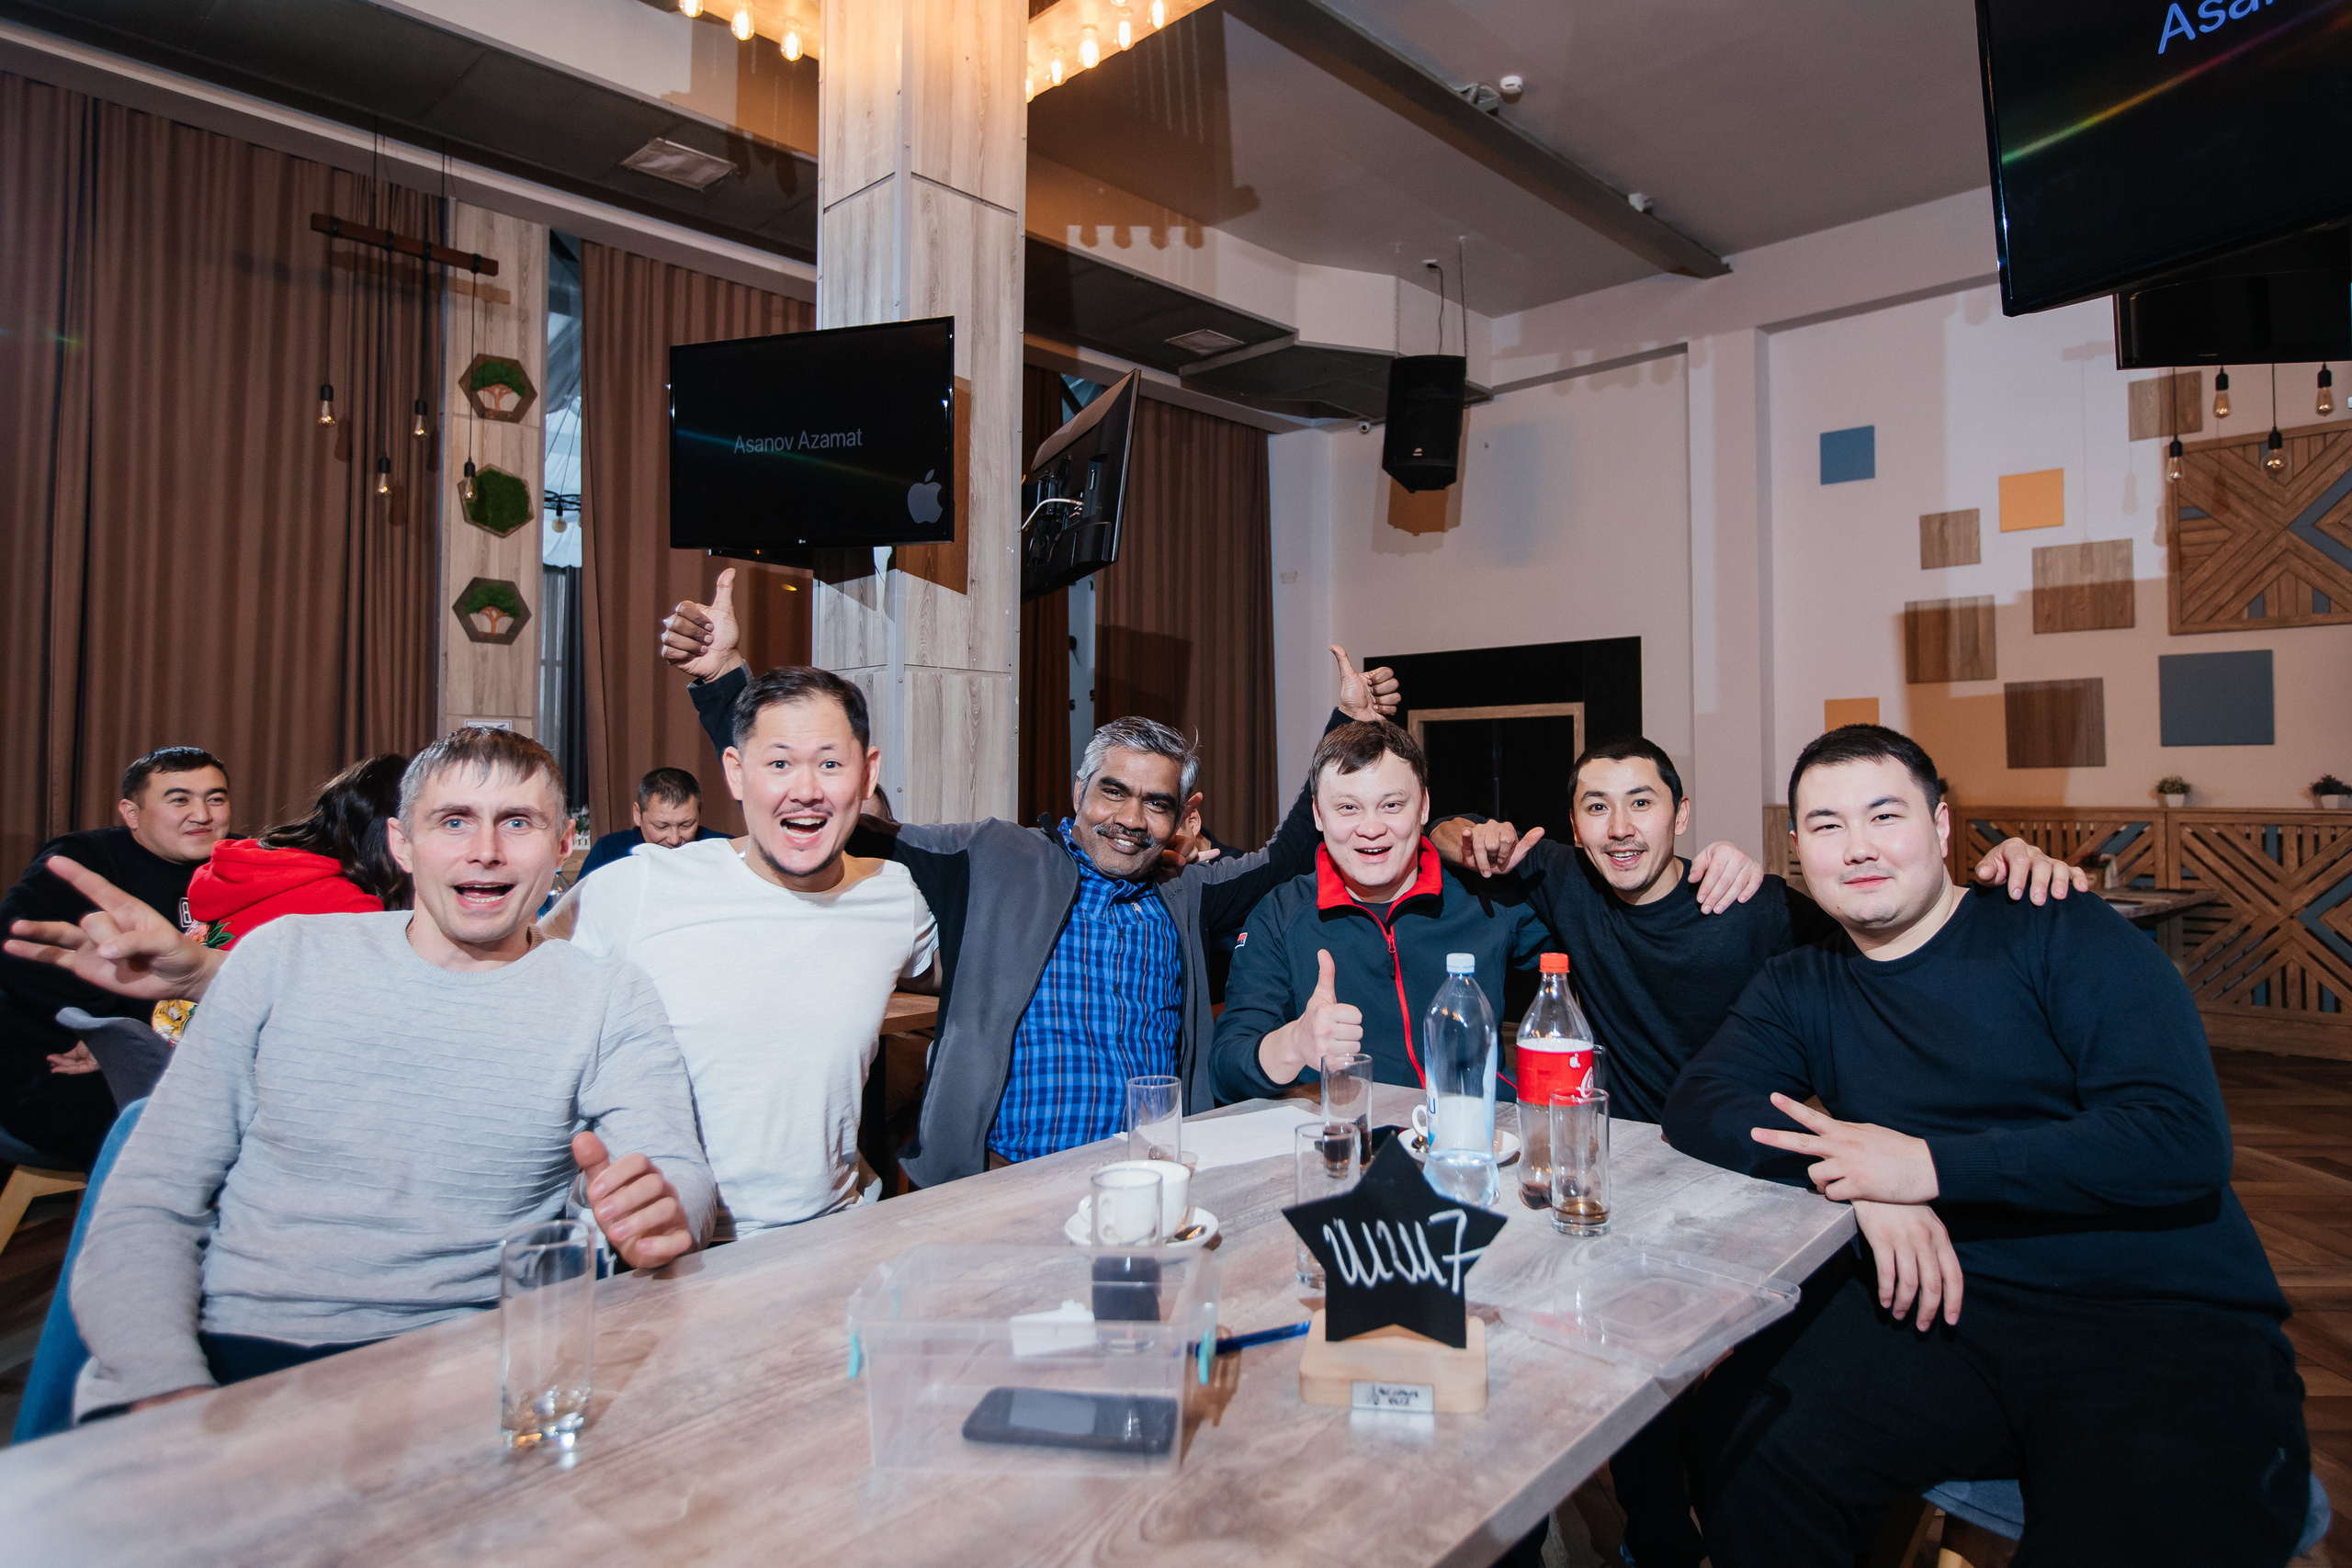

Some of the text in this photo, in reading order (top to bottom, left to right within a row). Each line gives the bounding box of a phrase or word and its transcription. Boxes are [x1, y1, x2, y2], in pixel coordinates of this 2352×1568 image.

[2157, 0, 2274, 54] Asa
[733, 428, 863, 454] Asanov Azamat
